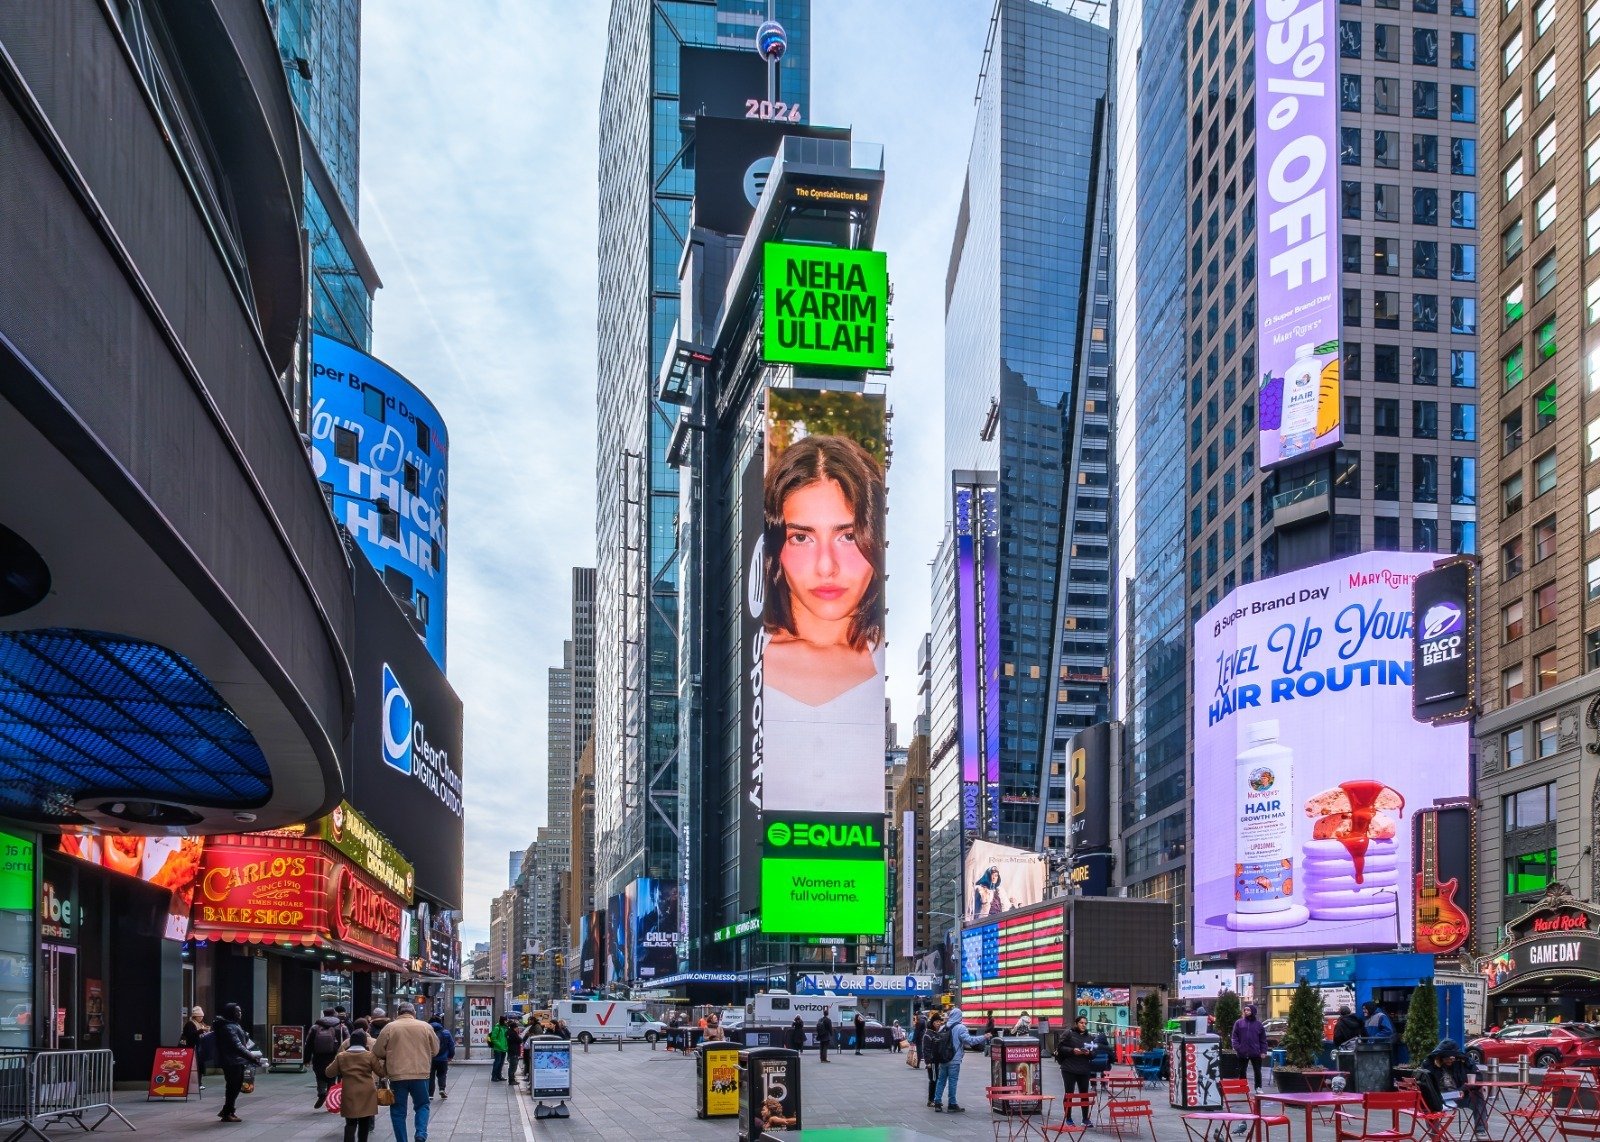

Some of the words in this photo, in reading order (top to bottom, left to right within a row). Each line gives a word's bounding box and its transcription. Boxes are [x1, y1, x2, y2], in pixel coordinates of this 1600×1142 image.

[745, 99, 802, 122] 2026
[796, 187, 809, 197] The
[1267, 134, 1327, 291] OFF
[786, 258, 867, 293] NEHA
[775, 288, 877, 324] KARIM
[1273, 309, 1294, 323] Super
[1294, 298, 1316, 314] Brand
[1316, 292, 1332, 305] Day
[777, 319, 875, 354] ULLAH
[346, 500, 435, 580] HAIR
[1222, 605, 1249, 631] Super
[1251, 594, 1296, 615] Brand
[1299, 586, 1331, 603] Day
[1420, 635, 1461, 656] TACO
[1423, 647, 1462, 667] BELL
[1208, 687, 1262, 728] HAIR
[1240, 814, 1271, 823] GROWTH
[1271, 811, 1286, 820] MAX
[1245, 799, 1281, 815] HAIR
[793, 823, 881, 847] EQUAL
[203, 857, 306, 902] CARLO'S
[257, 881, 282, 893] SINCE
[792, 876, 841, 889] Women
[842, 879, 856, 889] at
[248, 898, 272, 906] TIMES
[272, 899, 304, 908] SQUARE
[790, 890, 809, 902] full
[810, 892, 860, 903] volume.
[203, 905, 252, 923] BAKE
[253, 908, 304, 925] SHOP
[1534, 917, 1560, 932] Hard
[1560, 912, 1588, 931] Rock
[646, 931, 668, 943] CALL
[1529, 944, 1559, 965] GAME
[1559, 941, 1581, 962] DAY
[1187, 960, 1203, 971] AT&T
[804, 974, 831, 990] NEW
[832, 975, 863, 990] YORK
[865, 976, 901, 990] POLICE
[905, 976, 934, 991] DEPT
[470, 997, 492, 1006] ATM
[793, 1002, 830, 1012] verizon
[471, 1009, 492, 1017] Drink
[471, 1018, 491, 1027] Candy
[864, 1035, 885, 1043] asdaq
[763, 1066, 787, 1074] HELLO
[1186, 1043, 1198, 1107] CHICAGO
[760, 1072, 788, 1103] 15
